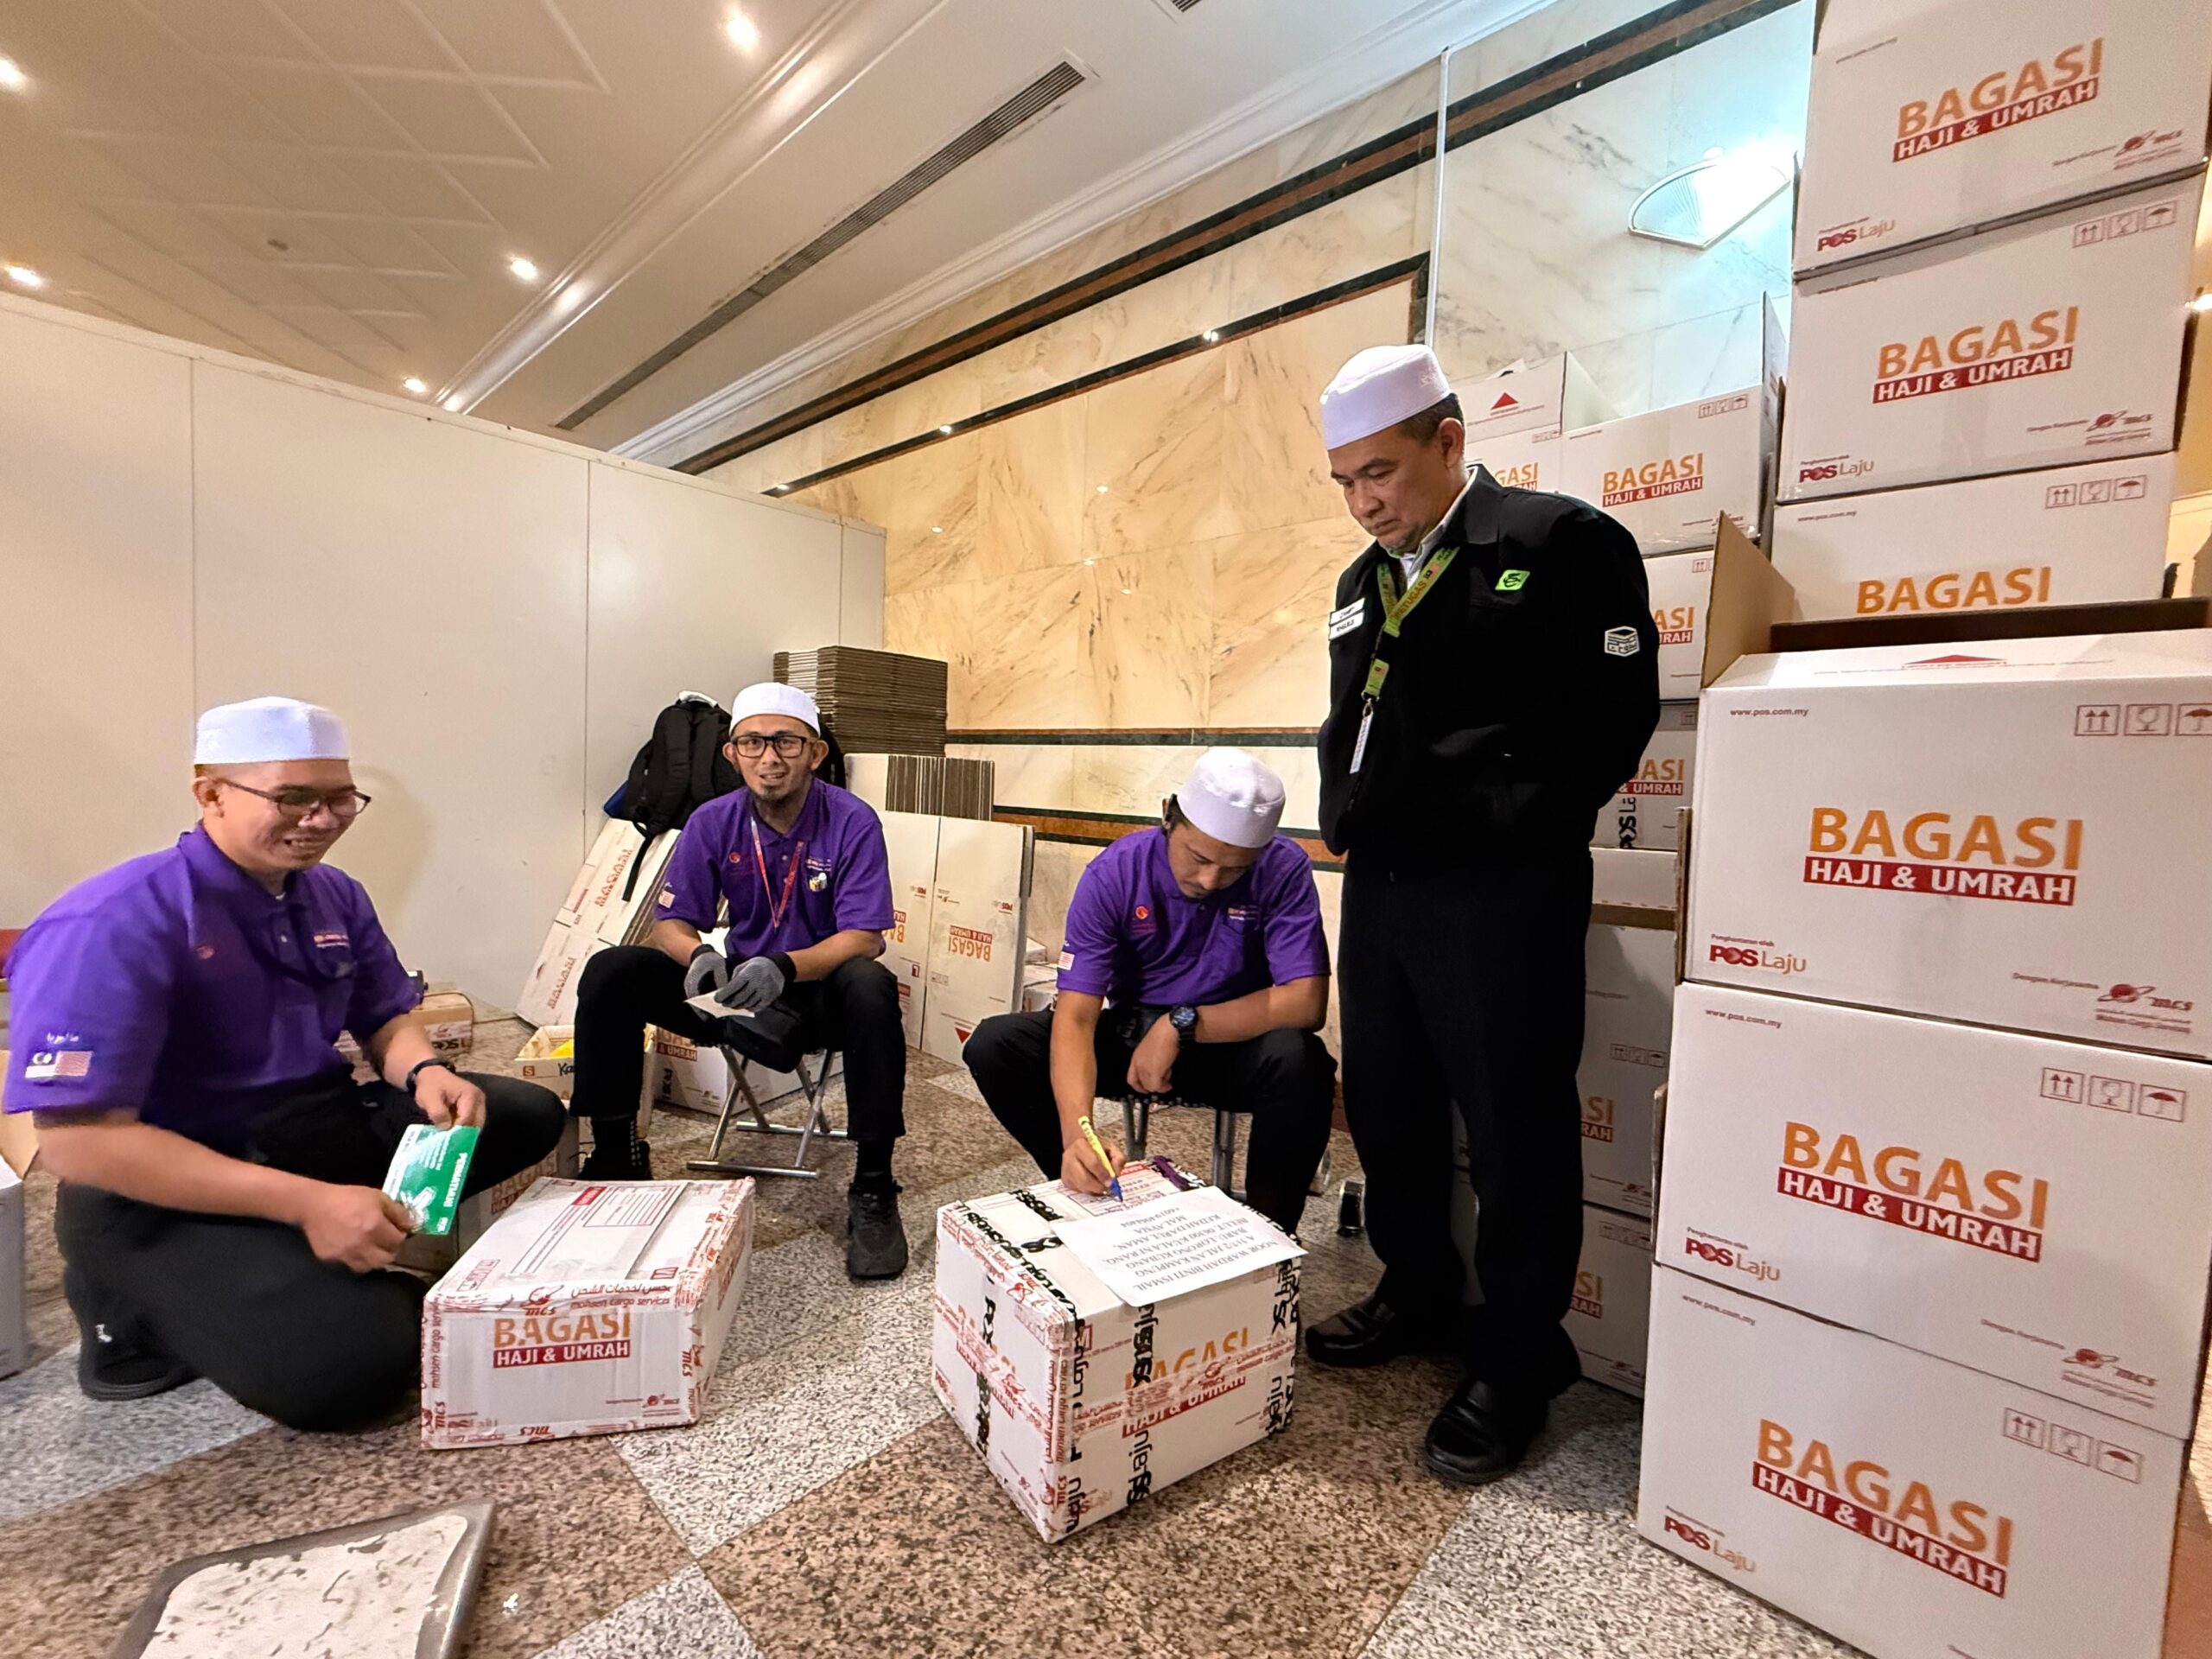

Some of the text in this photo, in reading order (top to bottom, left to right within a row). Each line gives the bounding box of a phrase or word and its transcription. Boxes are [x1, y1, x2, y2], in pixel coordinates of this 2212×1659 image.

[1896, 37, 2104, 138] BAGASI
[1898, 82, 2097, 158] HAJI & UMRAH
[1859, 219, 1895, 238] Laju
[1878, 306, 2079, 379] BAGASI
[1878, 349, 2070, 401] HAJI & UMRAH
[1494, 462, 1539, 486] GASI
[1603, 453, 1704, 493] BAGASI
[1839, 460, 1874, 476] Laju
[1605, 477, 1702, 506] HAJI & UMRAH
[1857, 567, 2051, 614] BAGASI
[1654, 607, 1694, 632] ASI
[1730, 709, 1809, 717] www.pos.com.my
[1633, 782, 1683, 794] UMRAH
[1809, 807, 2084, 870] BAGASI
[1811, 860, 2071, 902] HAJI & UMRAH
[949, 935, 991, 962] BAGASI
[1761, 950, 1807, 975] Laju
[1706, 1009, 1782, 1029] www.pos.com.my
[667, 1046, 697, 1060] UMRAH
[525, 1066, 534, 1077] S
[1783, 1121, 2050, 1230] BAGASI
[1783, 1172, 2039, 1260] HAJI & UMRAH
[1173, 1265, 1205, 1279] BINTI
[1735, 1253, 1780, 1281] Laju
[608, 1298, 636, 1308] cargo
[493, 1312, 631, 1349] BAGASI
[496, 1341, 629, 1367] HAJI & UMRAH
[1758, 1419, 2013, 1567] BAGASI
[1758, 1467, 2003, 1594] HAJI & UMRAH
[1713, 1539, 1756, 1573] Laju
